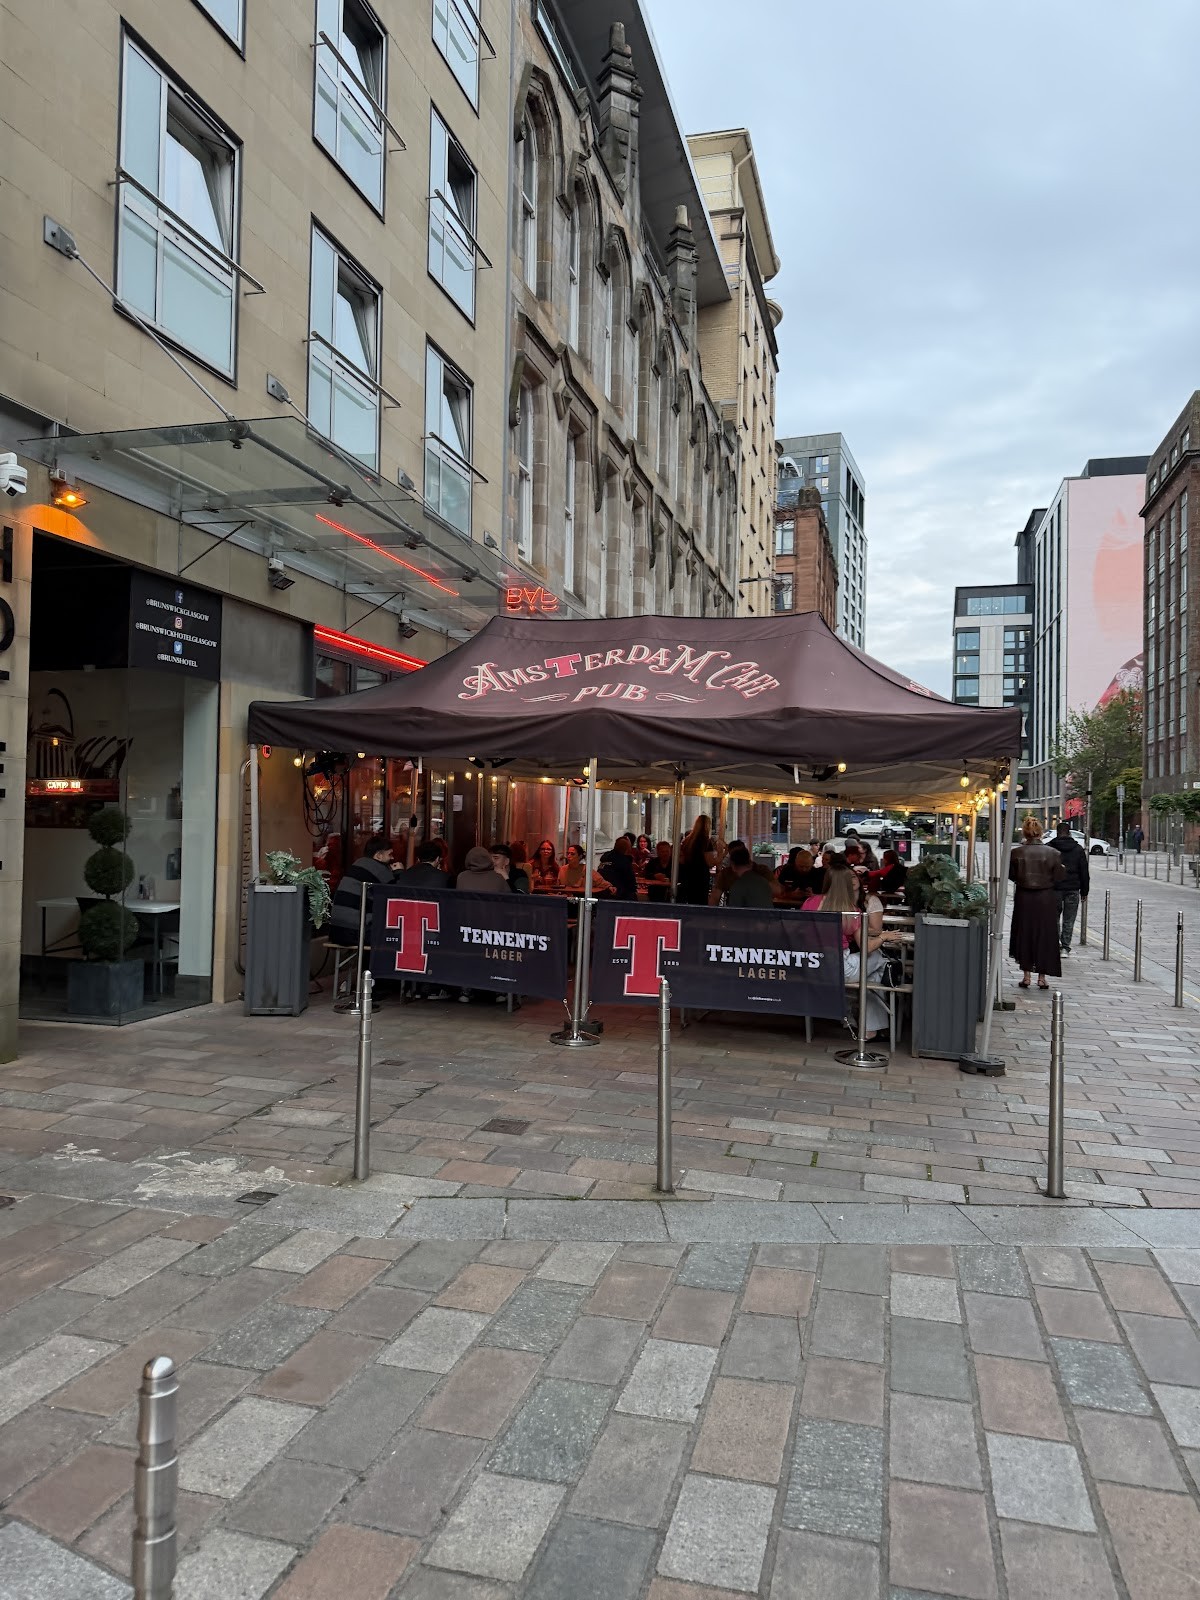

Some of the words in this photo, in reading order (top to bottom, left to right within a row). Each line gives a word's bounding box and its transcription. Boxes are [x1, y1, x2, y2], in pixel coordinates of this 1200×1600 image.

[146, 599, 209, 621] @BRUNSWICKGLASGOW
[136, 622, 217, 647] @BRUNSWICKHOTELGLASGOW
[157, 654, 198, 667] @BRUNSHOTEL
[458, 645, 730, 699] AMSTERDAM
[571, 683, 649, 703] PUB
[385, 898, 441, 975] T
[460, 926, 548, 951] TENNENT'S
[484, 947, 523, 963] LAGER
[613, 916, 681, 997] T
[706, 944, 822, 970] TENNENT'S
[738, 966, 788, 982] LAGER
